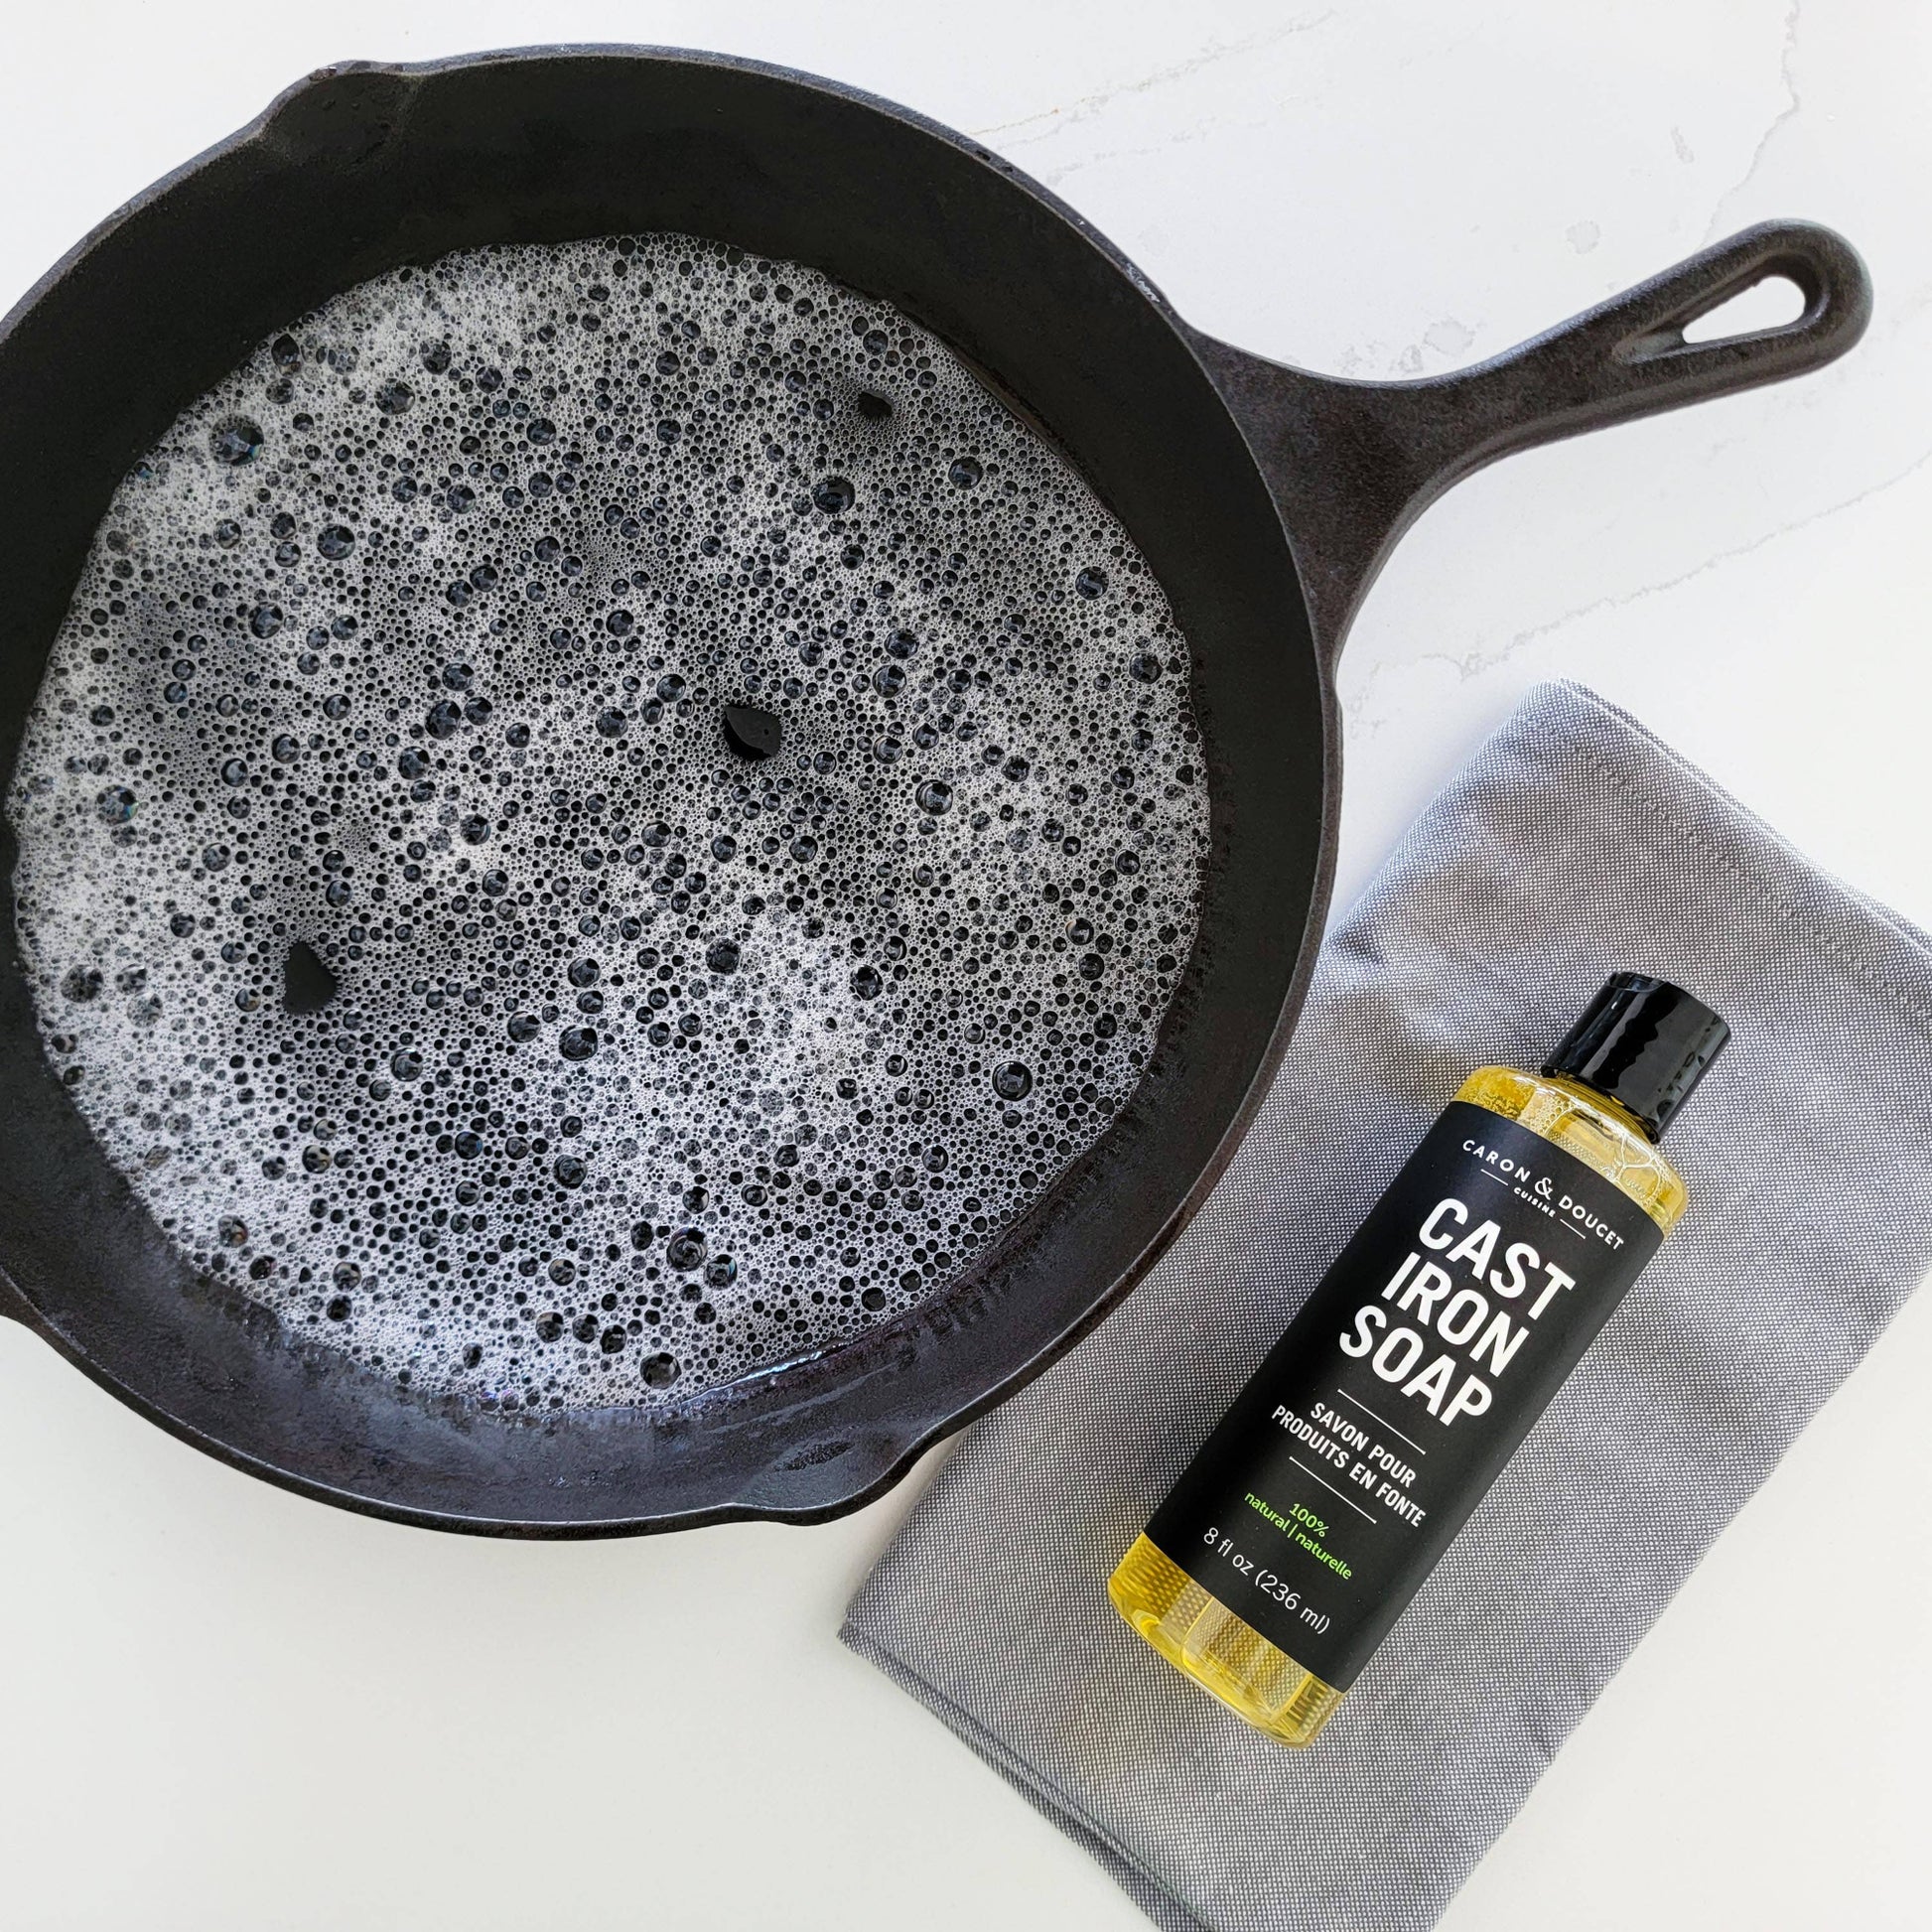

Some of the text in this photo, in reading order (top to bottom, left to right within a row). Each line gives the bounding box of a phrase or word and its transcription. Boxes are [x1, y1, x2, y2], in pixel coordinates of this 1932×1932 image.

[1462, 1140, 1624, 1250] CARON & DOUCET
[1513, 1186, 1557, 1218] CUISINE
[1420, 1197, 1577, 1320] CAST
[1338, 1305, 1493, 1427] SOAP
[1380, 1251, 1530, 1378] IRON
[1271, 1404, 1427, 1528] PRODUITS EN FONTE
[1310, 1402, 1417, 1488] SAVON POUR
[1289, 1502, 1329, 1538] 100%
[1203, 1527, 1330, 1635] 8 fl oz (236 ml)
